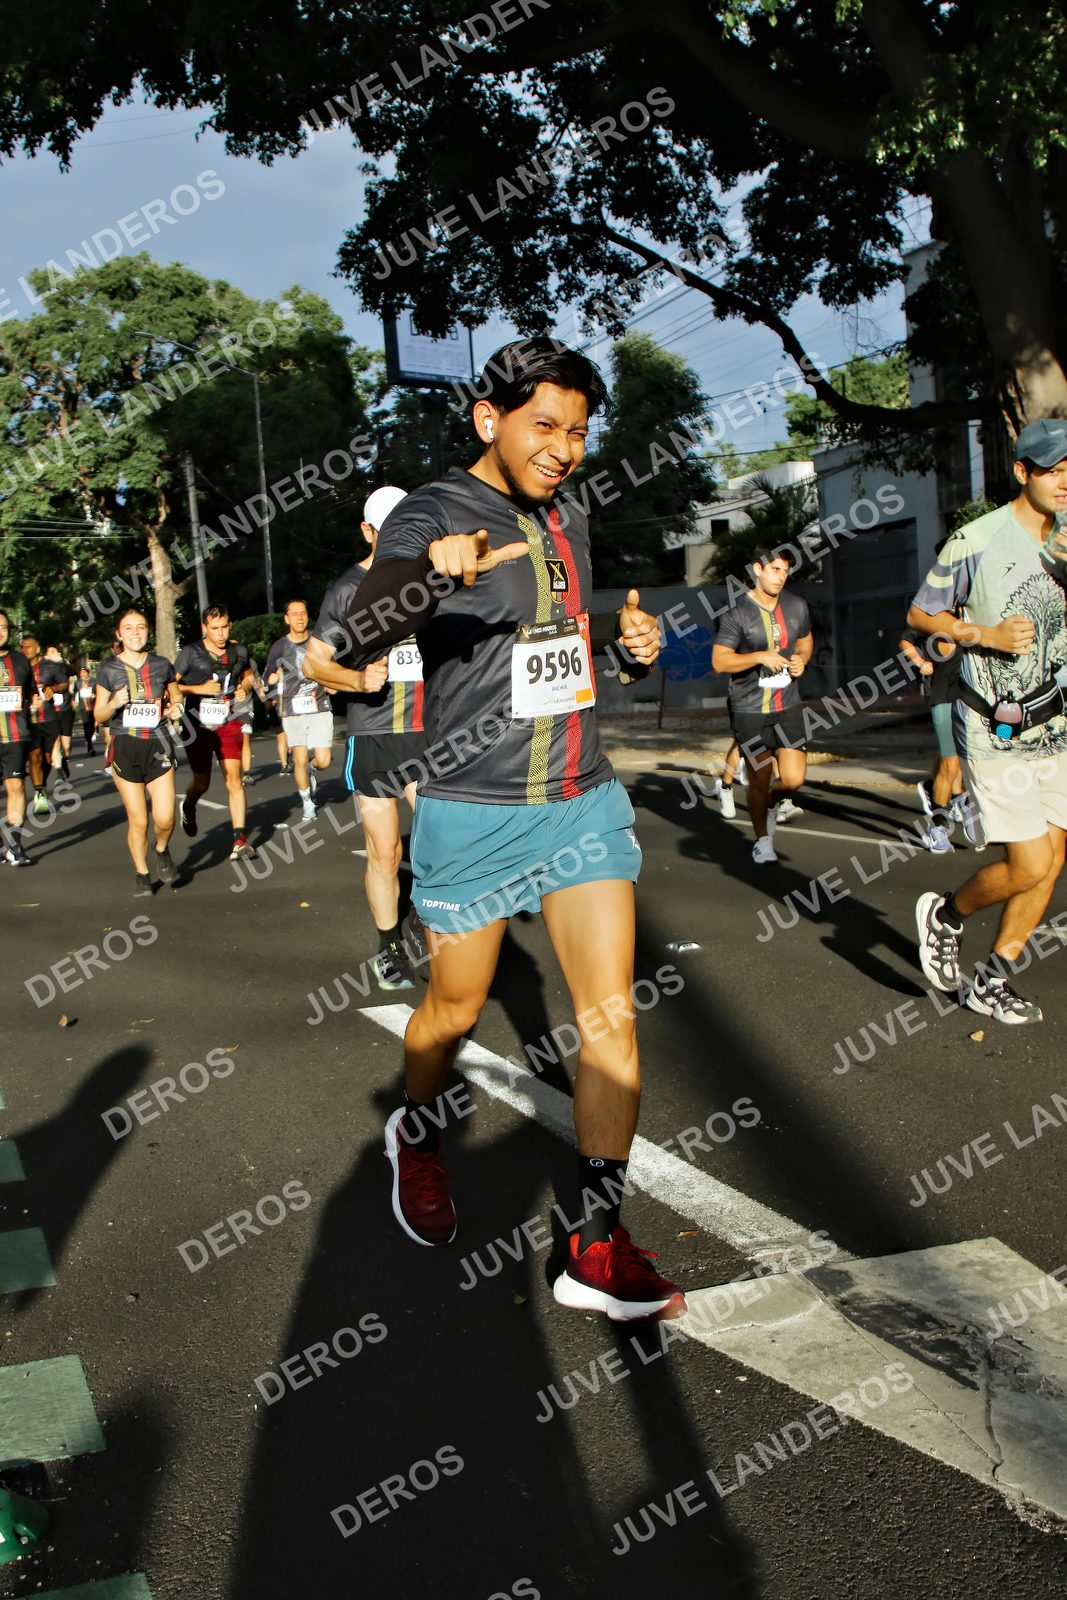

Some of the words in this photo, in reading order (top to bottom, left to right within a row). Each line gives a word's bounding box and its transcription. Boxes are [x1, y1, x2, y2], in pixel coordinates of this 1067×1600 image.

[526, 646, 583, 685] 9596
[127, 706, 157, 717] 10499
[422, 899, 461, 912] TOPTIME
